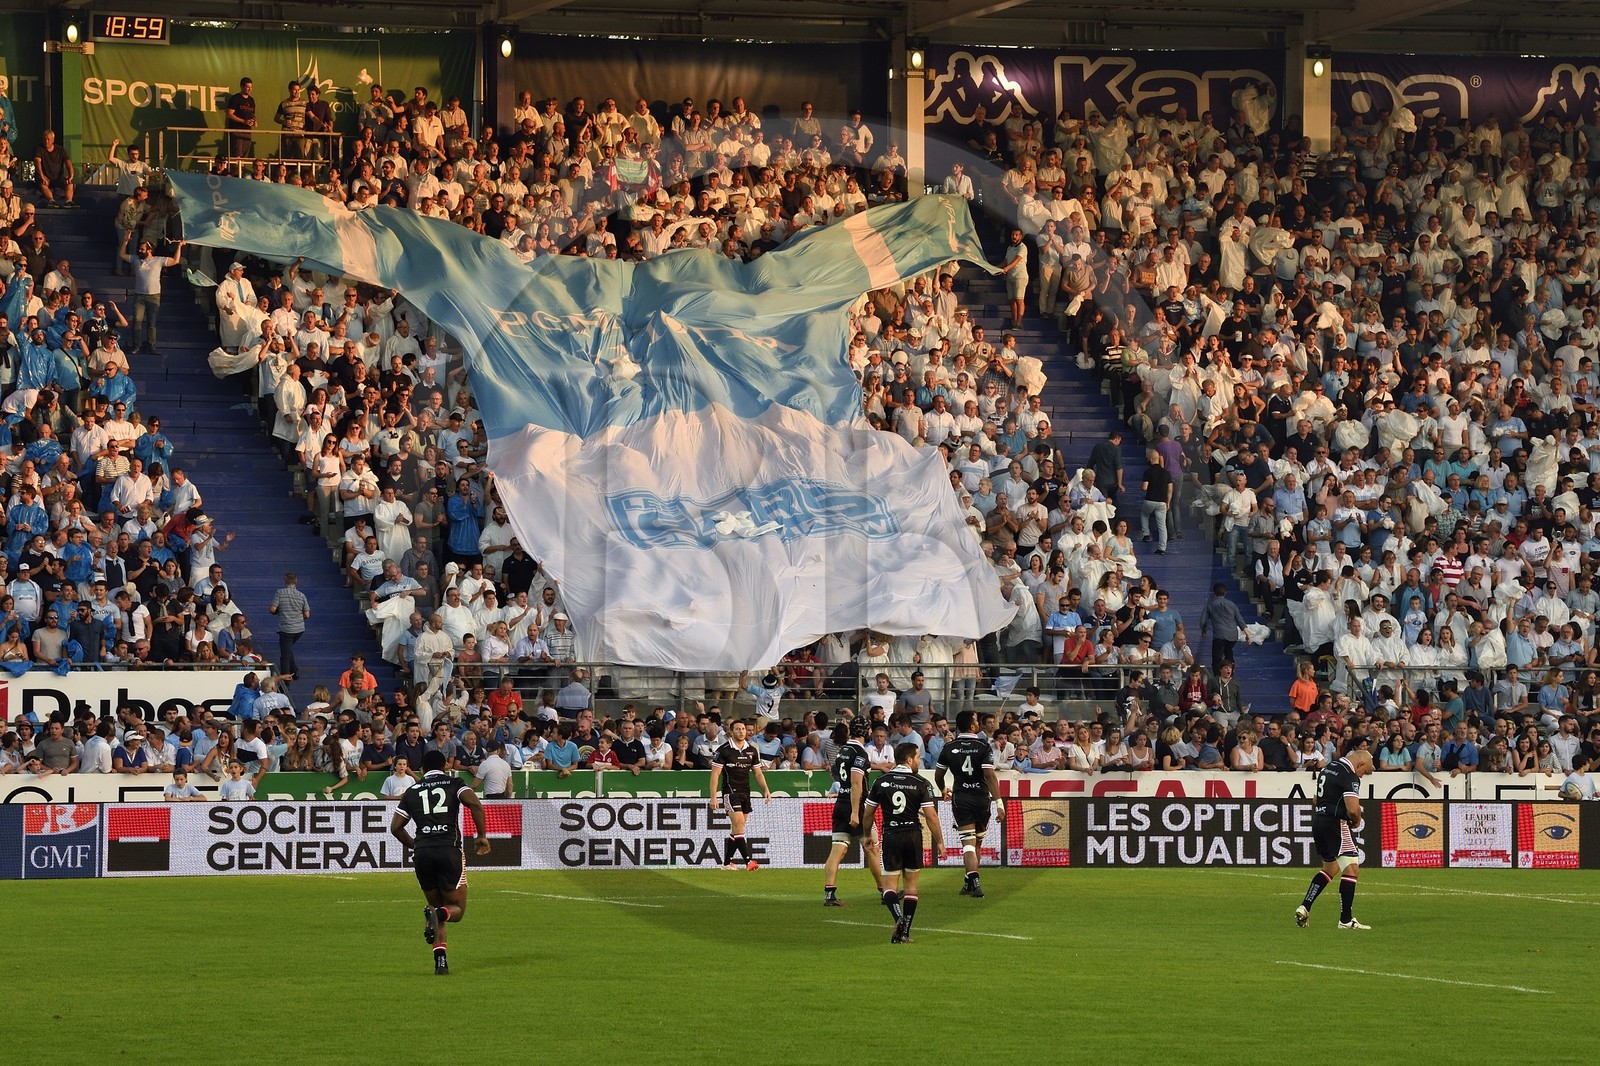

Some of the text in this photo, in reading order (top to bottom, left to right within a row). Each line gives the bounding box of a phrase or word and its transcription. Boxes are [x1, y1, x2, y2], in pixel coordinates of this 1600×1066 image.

[104, 16, 164, 39] 18:59
[83, 76, 231, 113] SPORTIF
[839, 761, 848, 782] 6
[961, 755, 974, 776] 4
[1318, 774, 1326, 798] 3
[418, 787, 449, 815] 12
[891, 790, 907, 815] 9
[207, 804, 387, 835] SOCIETE
[559, 802, 731, 831] SOCIETE
[1087, 803, 1366, 832] LES OPTICIE
[30, 846, 91, 869] GMF
[1087, 835, 1366, 866] MUTUALIST
